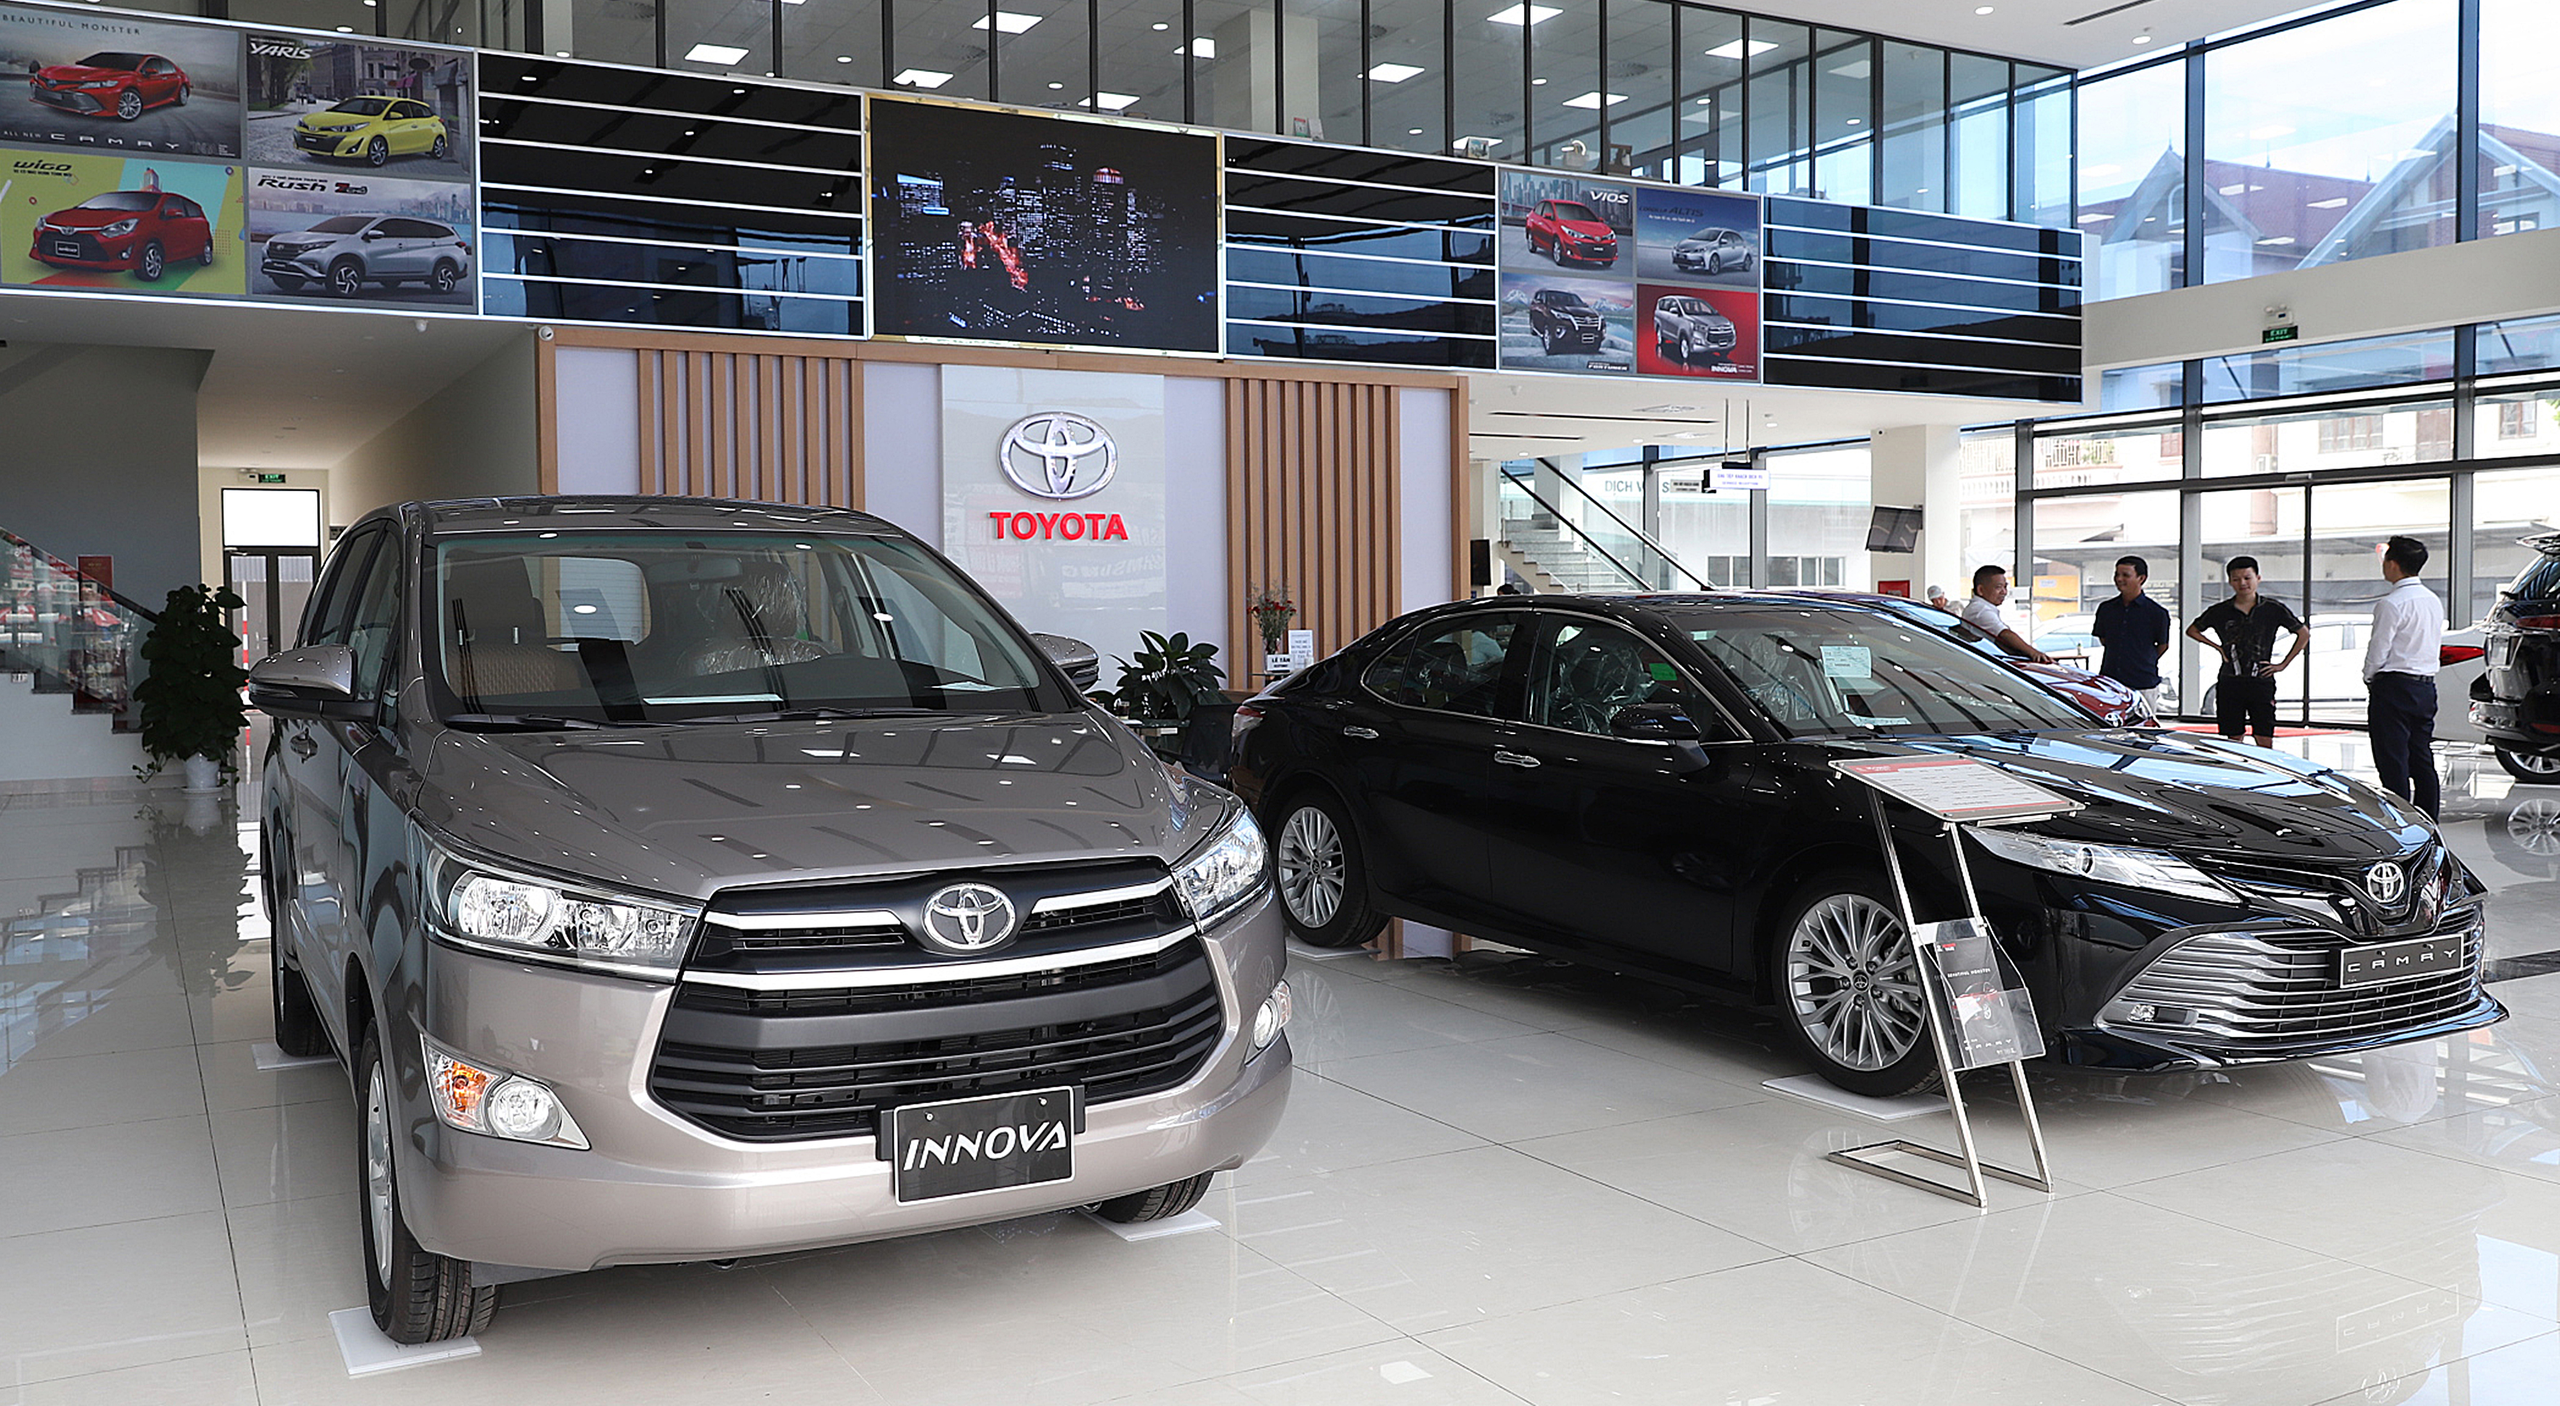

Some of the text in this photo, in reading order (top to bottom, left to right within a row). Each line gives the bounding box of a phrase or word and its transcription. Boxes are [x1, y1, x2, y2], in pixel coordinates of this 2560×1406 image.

[2, 14, 140, 35] BEAUTIFUL MONSTER
[250, 42, 313, 59] YARIS
[258, 178, 327, 192] Rush
[1590, 190, 1629, 204] VIOS
[1711, 365, 1738, 373] INNOVA
[989, 511, 1128, 540] TOYOTA
[2347, 949, 2457, 973] CAMRY
[903, 1120, 1067, 1171] INNOVA
